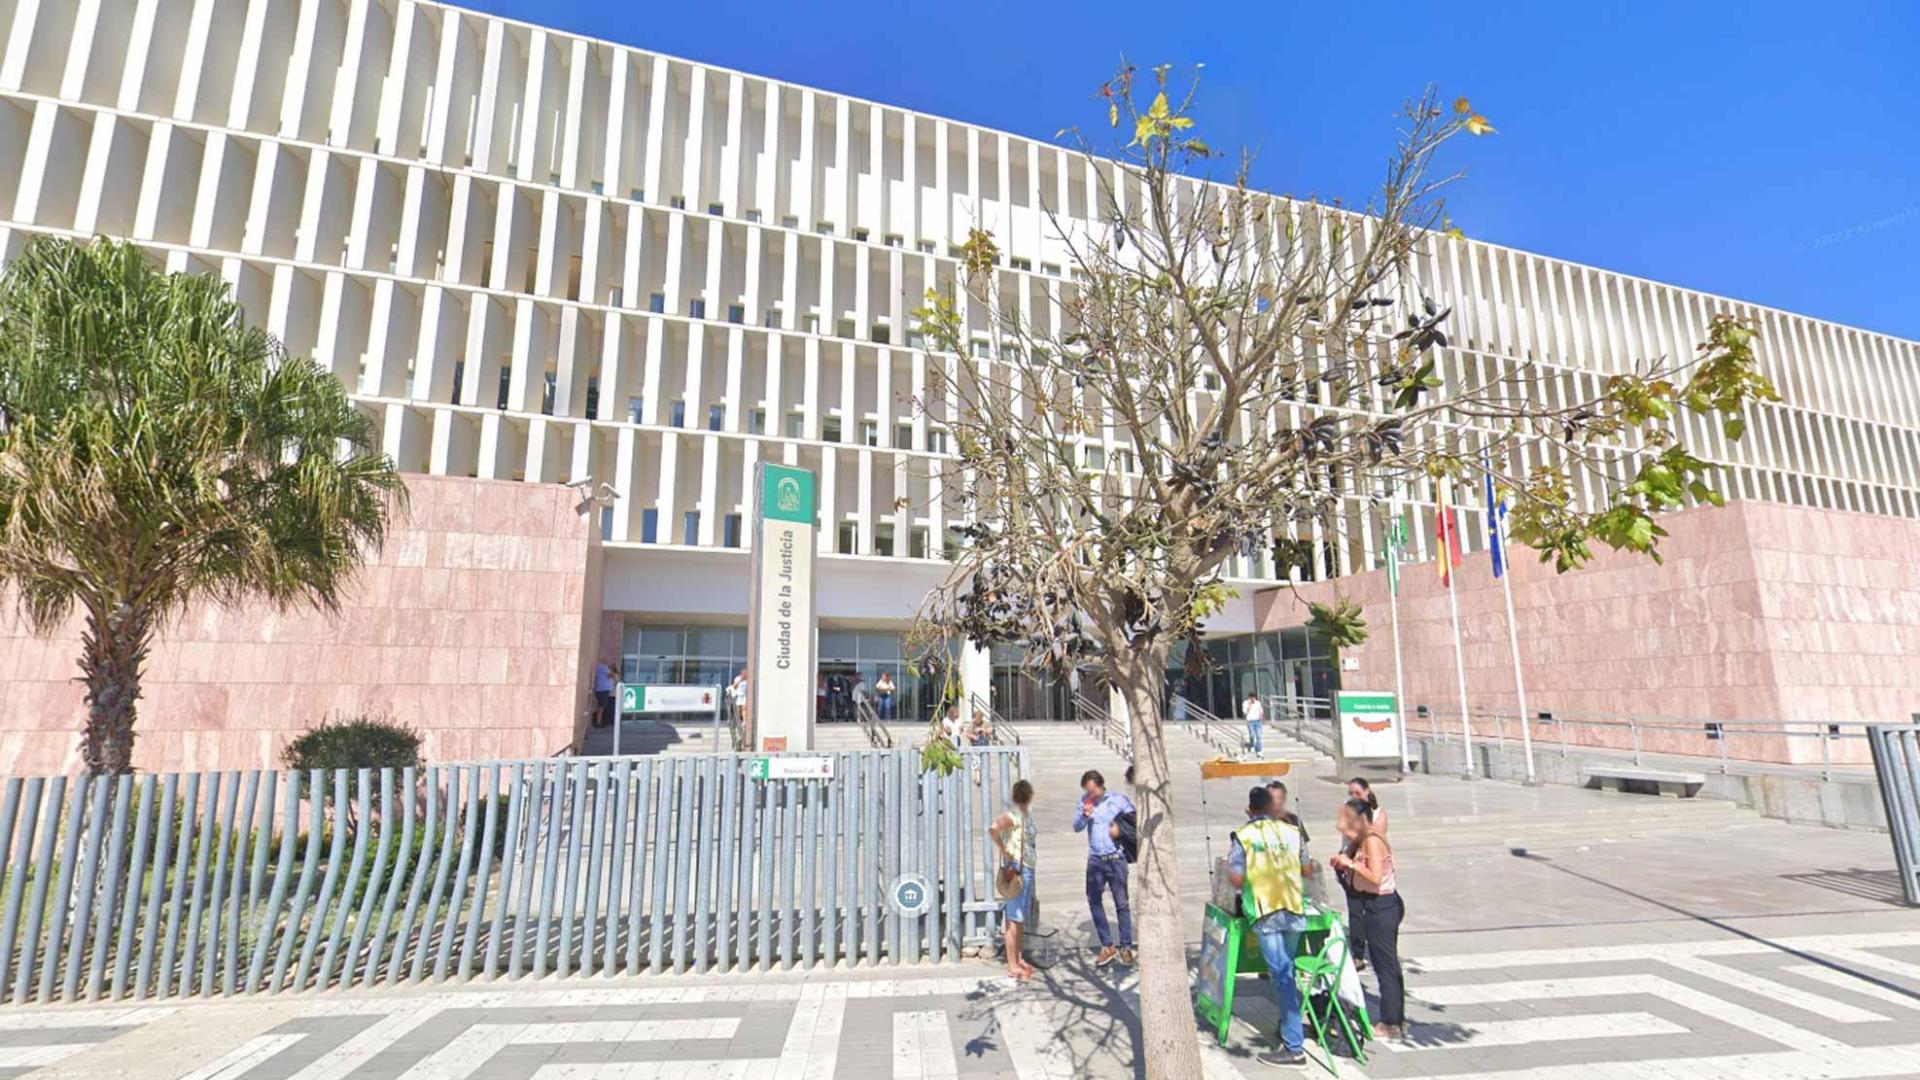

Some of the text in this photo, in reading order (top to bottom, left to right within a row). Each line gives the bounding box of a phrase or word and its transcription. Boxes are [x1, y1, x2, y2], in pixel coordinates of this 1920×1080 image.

[776, 530, 793, 670] Ciudad de la Justicia
